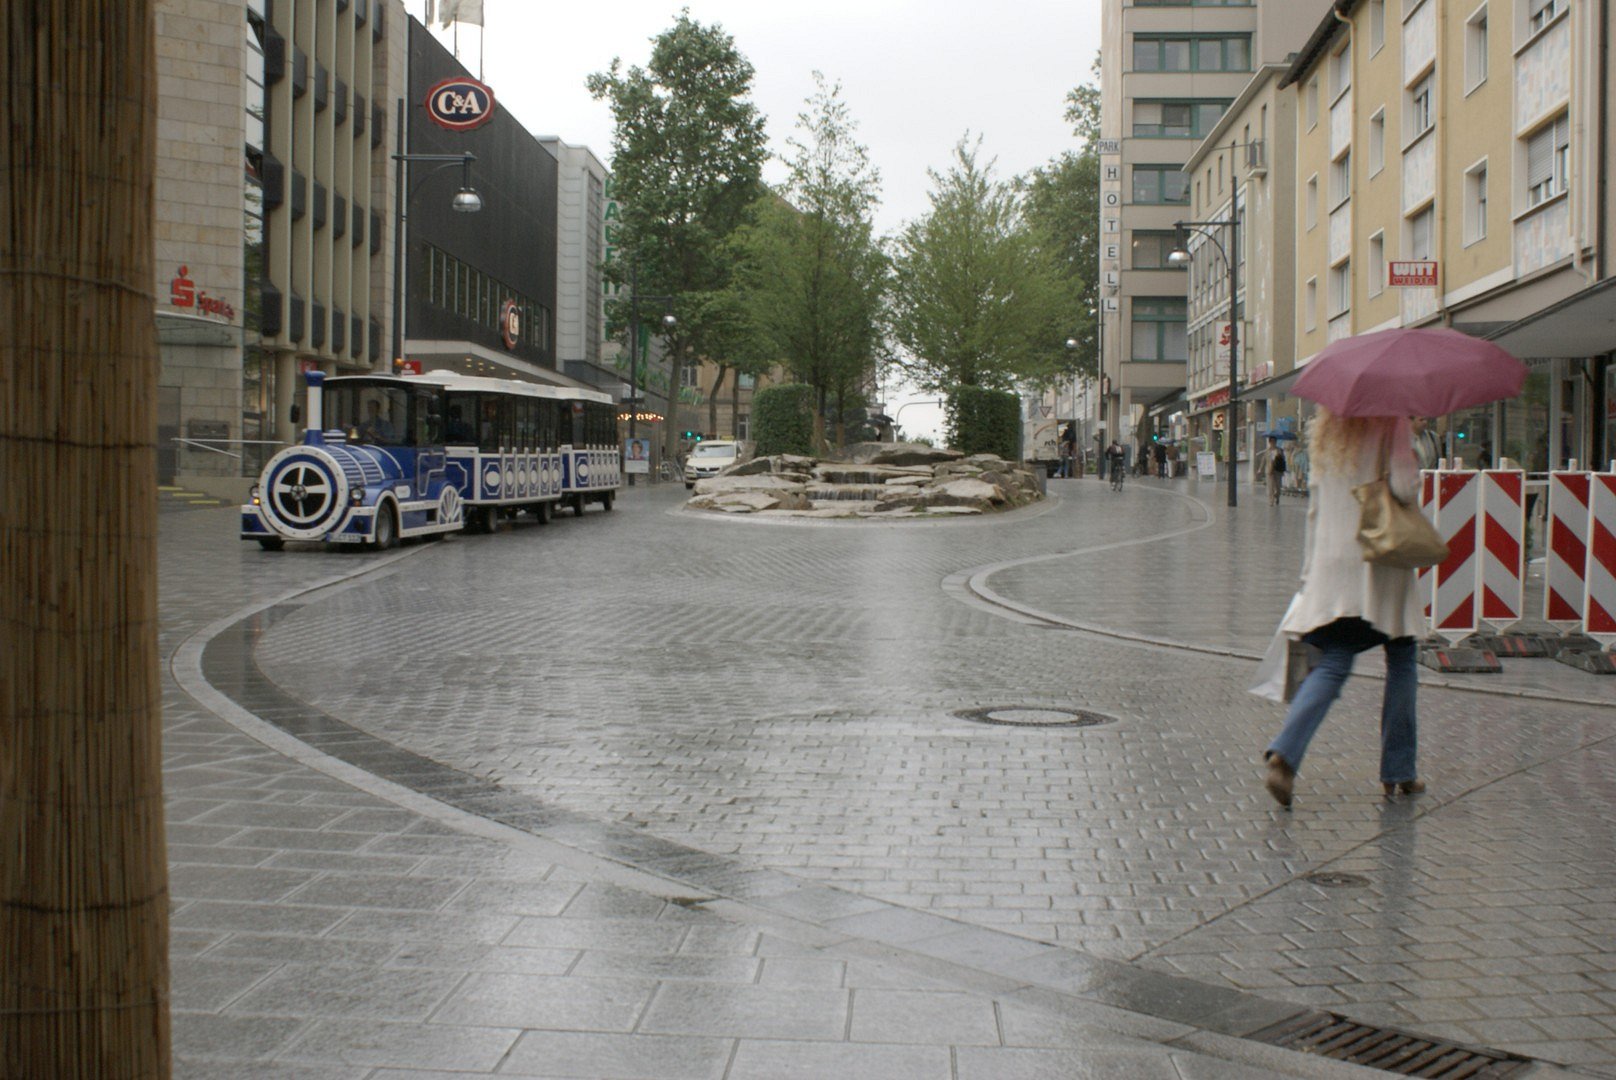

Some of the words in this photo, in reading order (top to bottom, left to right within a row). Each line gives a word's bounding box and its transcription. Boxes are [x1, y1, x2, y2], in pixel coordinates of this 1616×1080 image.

[437, 90, 482, 115] C&A
[1099, 141, 1120, 153] PARK
[1392, 262, 1436, 276] WITT
